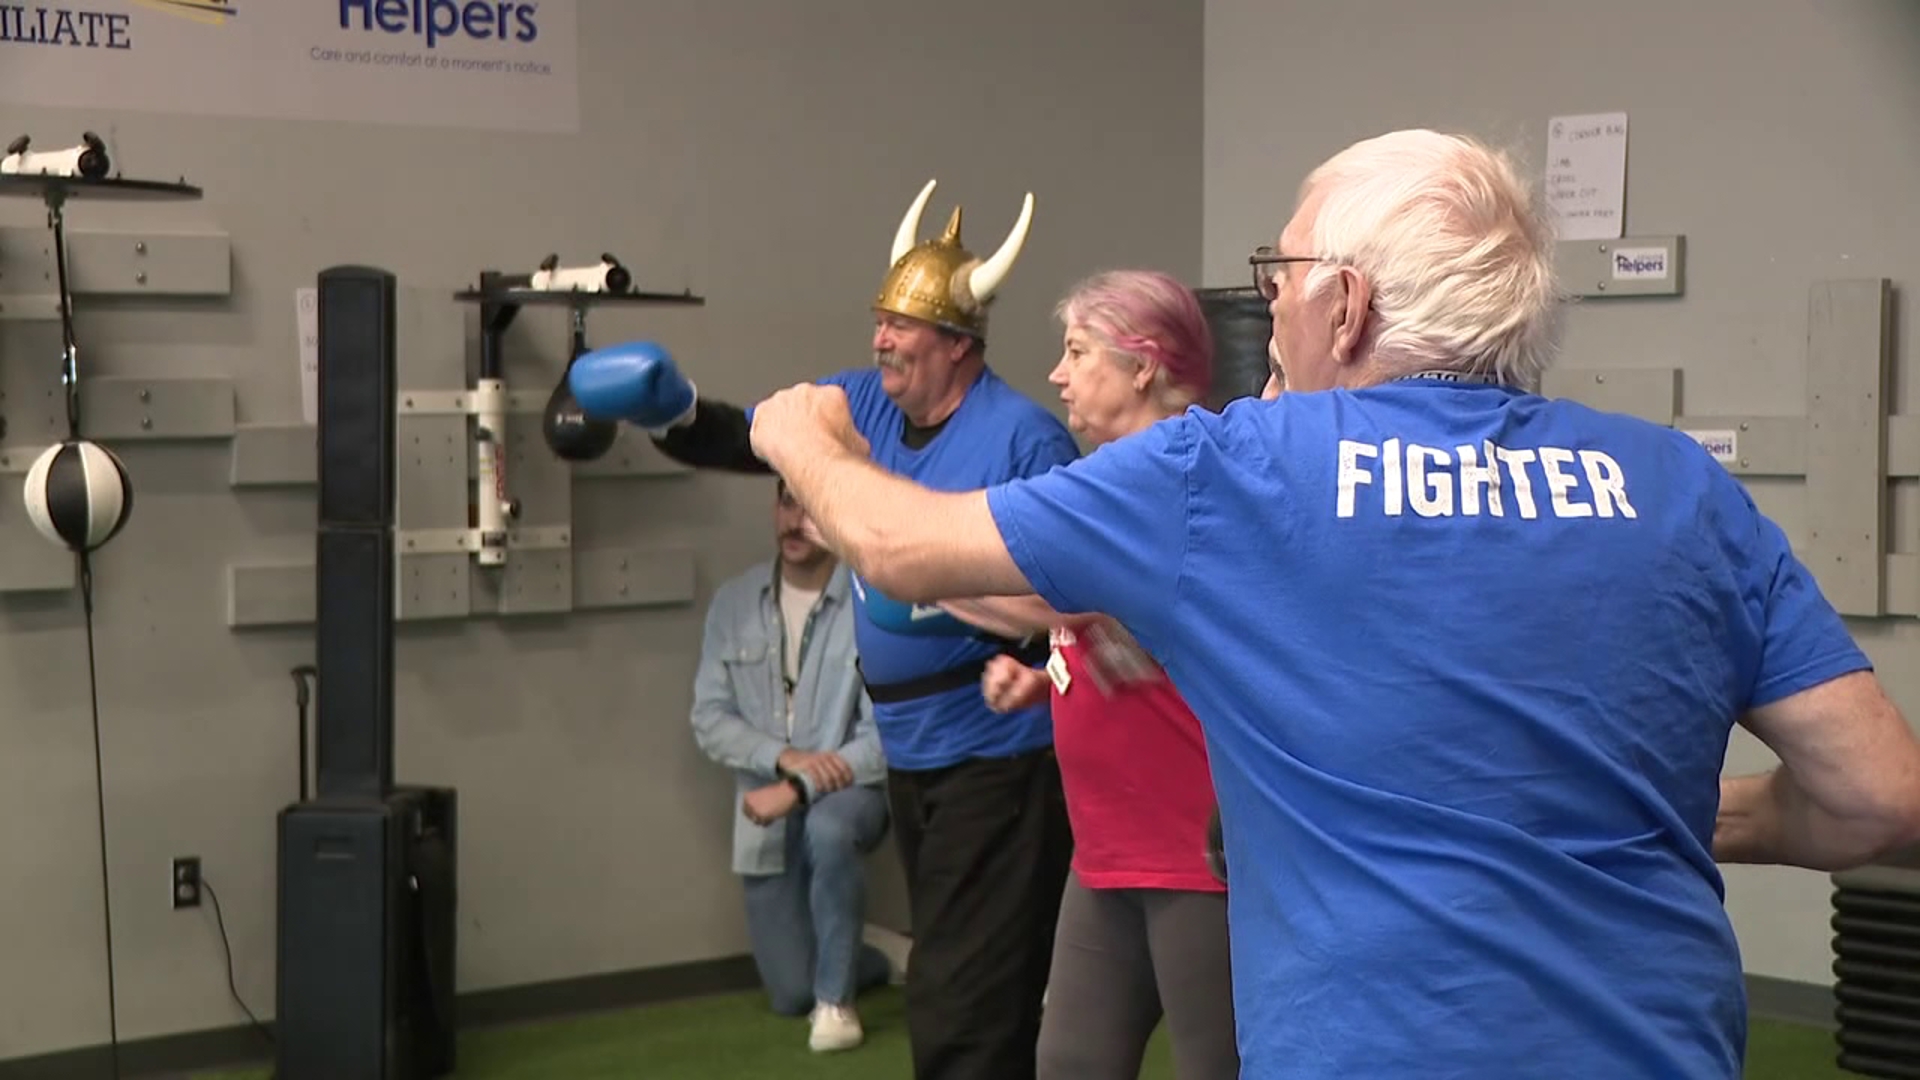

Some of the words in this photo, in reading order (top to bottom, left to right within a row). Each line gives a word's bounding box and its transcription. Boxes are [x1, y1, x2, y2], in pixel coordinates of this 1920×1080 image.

[310, 47, 342, 61] Care
[345, 50, 371, 64] and
[374, 51, 422, 66] comfort
[425, 54, 438, 68] at
[440, 58, 450, 69] a
[452, 58, 511, 72] moment's
[1617, 257, 1663, 275] Helpers
[1337, 438, 1638, 519] FIGHTER
